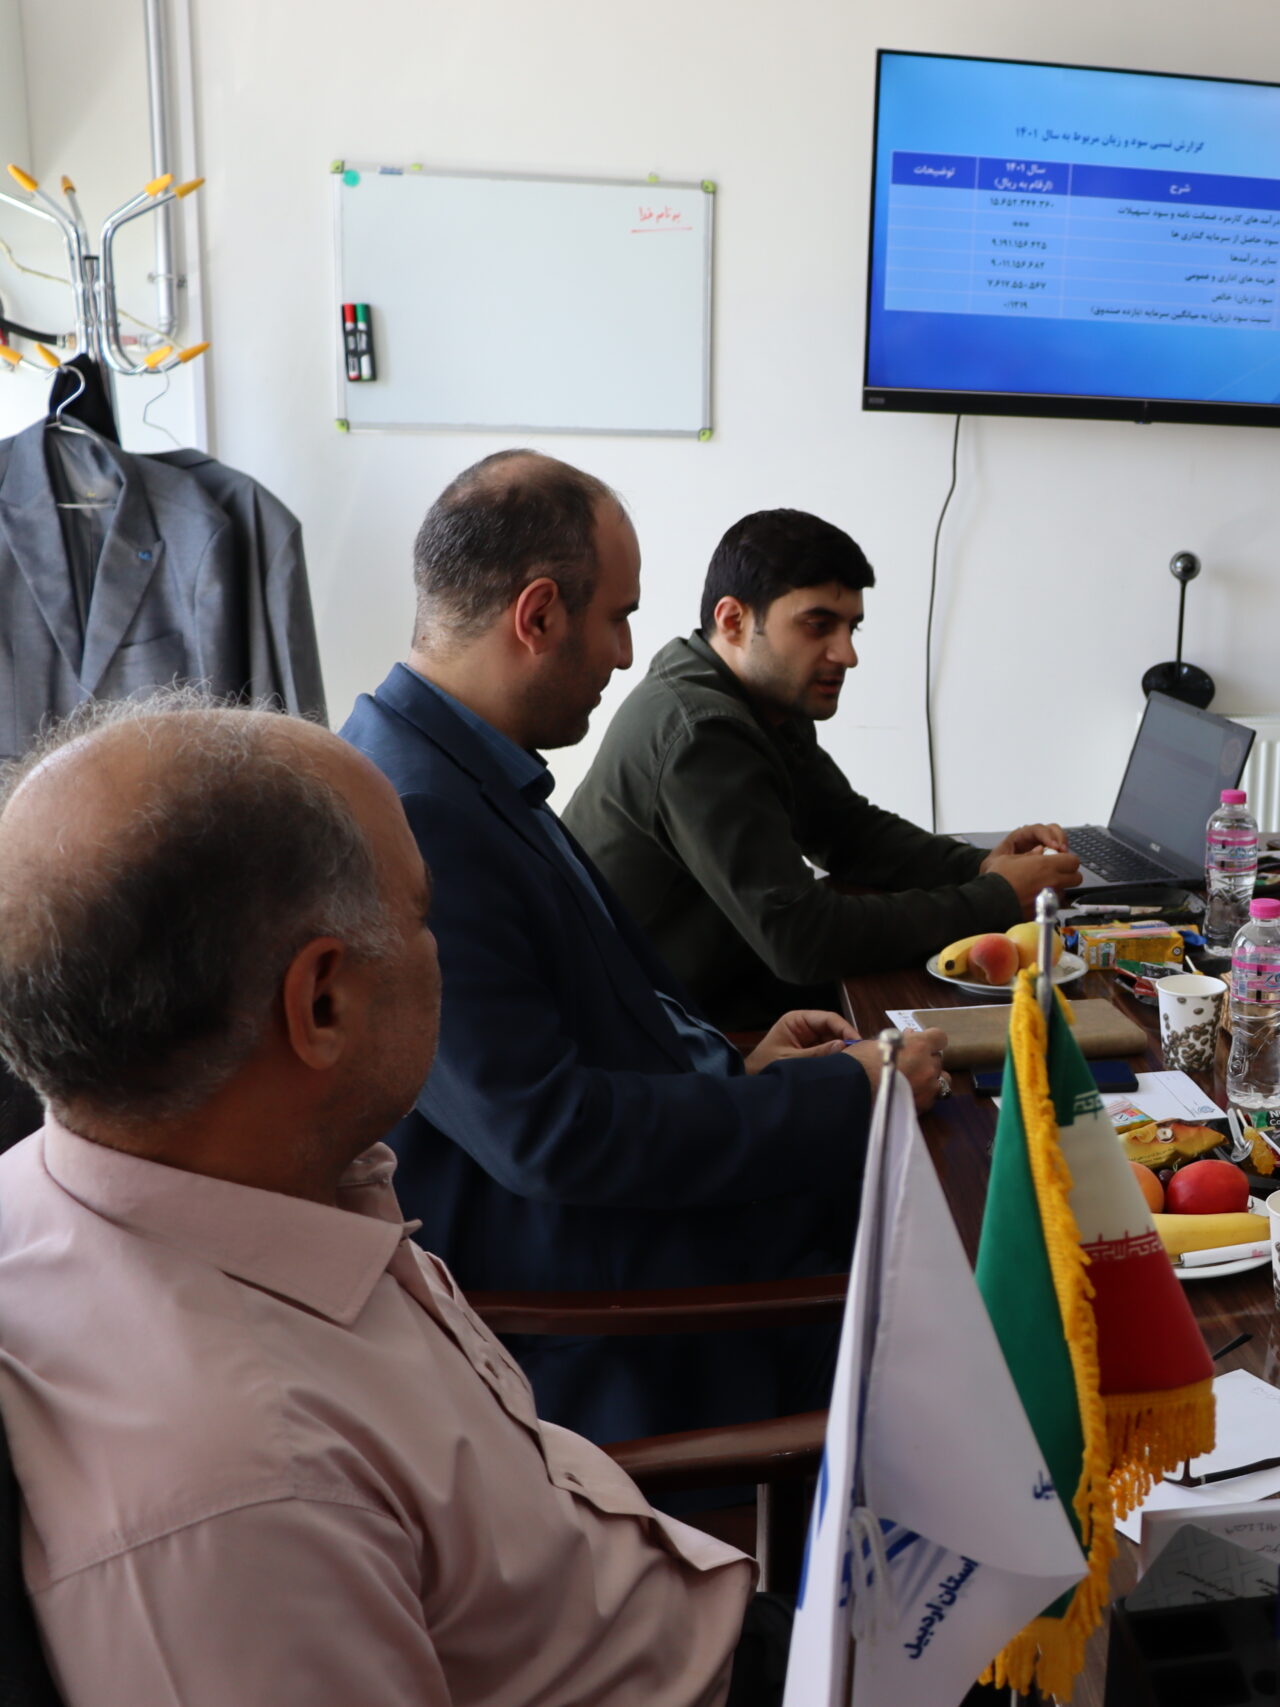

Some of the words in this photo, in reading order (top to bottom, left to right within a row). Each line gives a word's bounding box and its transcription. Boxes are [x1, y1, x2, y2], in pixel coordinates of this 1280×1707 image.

[1016, 126, 1037, 138] ۱۴۰۱
[1042, 128, 1060, 142] سال
[1062, 132, 1071, 143] به
[1074, 131, 1100, 146] مربوط
[1101, 133, 1121, 148] زیان
[1131, 137, 1148, 150] سود
[1173, 138, 1205, 154] گزارش
[913, 165, 956, 179] توضیحات
[1006, 162, 1025, 173] ۱۴۰۱
[1026, 163, 1047, 176] سال
[1169, 182, 1191, 194] شرح
